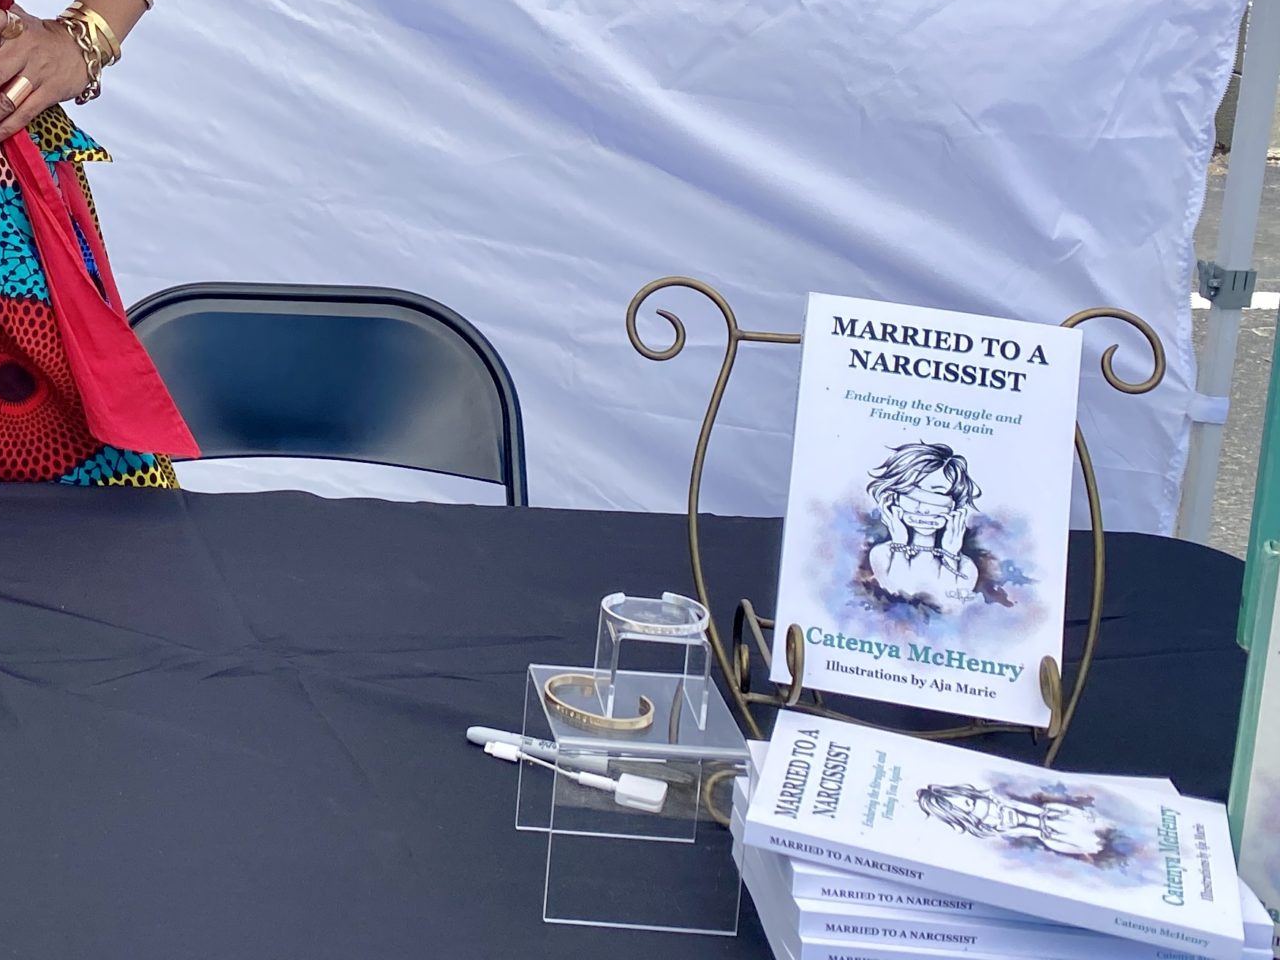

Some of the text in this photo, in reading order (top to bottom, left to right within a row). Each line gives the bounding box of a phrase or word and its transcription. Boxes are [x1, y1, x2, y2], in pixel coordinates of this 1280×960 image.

[831, 316, 1050, 365] MARRIED TO A
[848, 348, 1027, 392] NARCISSIST
[845, 389, 1023, 425] Enduring the Struggle and
[869, 408, 994, 436] Finding You Again
[806, 626, 1024, 682] Catenya McHenry
[825, 660, 997, 699] Illustrations by Aja Marie
[774, 729, 820, 819] MARRIED TO A
[812, 740, 851, 819] NARCISSIST
[770, 836, 925, 881] MARRIED TO A NARCISSIST
[1157, 805, 1188, 907] Catenya McHenry
[821, 887, 975, 910] MARRIED TO A NARCISSIST
[825, 922, 978, 945] MARRIED TO A NARCISSIST
[1115, 917, 1209, 948] Catenya McHenry
